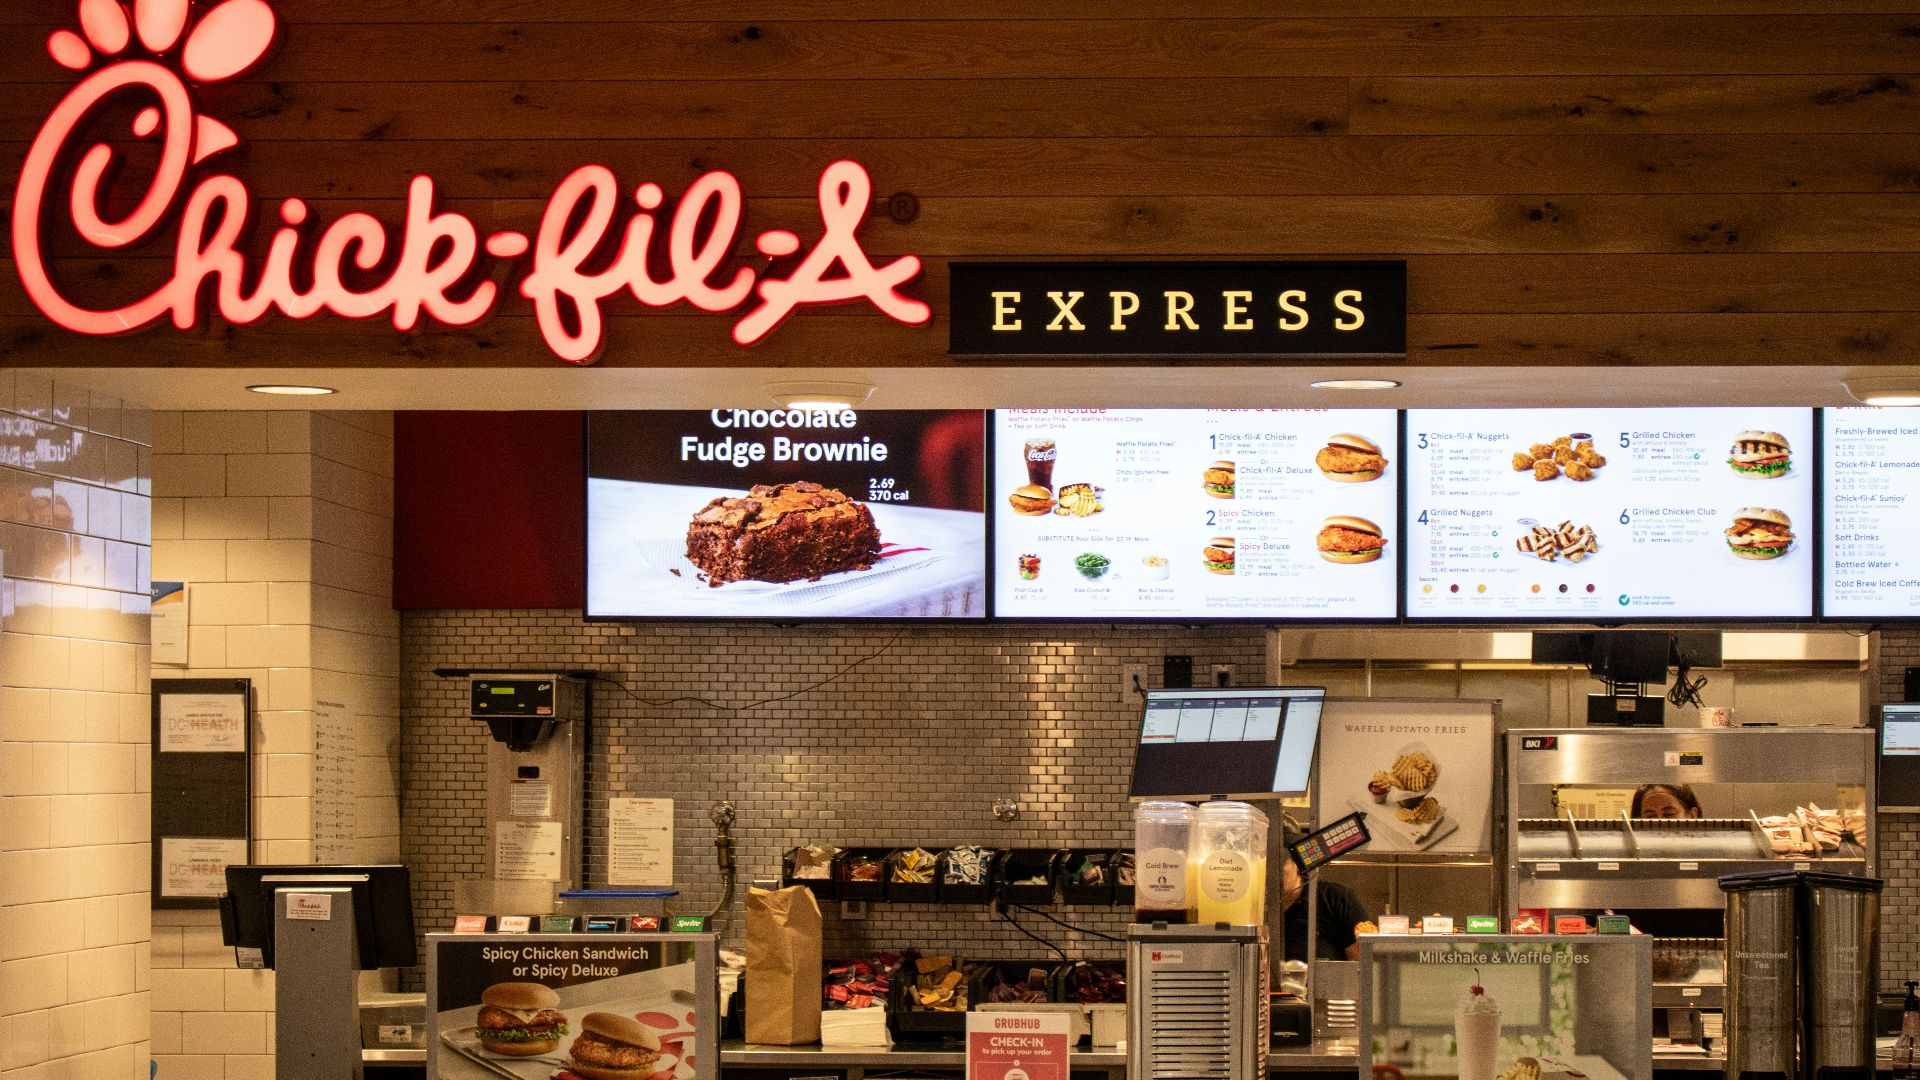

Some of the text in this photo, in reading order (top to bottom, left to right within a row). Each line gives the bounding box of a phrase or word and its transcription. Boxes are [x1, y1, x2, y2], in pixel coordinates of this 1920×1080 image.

[12, 58, 932, 363] Chick-fil-A
[991, 289, 1366, 332] EXPRESS
[711, 408, 857, 429] Chocolate
[1264, 433, 1298, 441] Chicken
[1477, 432, 1510, 442] Nuggets
[1632, 431, 1696, 439] Grilled Chicken
[1835, 427, 1918, 437] Freshly-Brewed Iced
[1209, 434, 1216, 450] 1
[1417, 433, 1428, 450] 3
[1619, 432, 1630, 449] 5
[680, 436, 888, 468] Fudge Brownie
[1286, 466, 1313, 474] Deluxe
[869, 478, 895, 489] 2.69
[869, 490, 909, 501] 370 cal
[1835, 494, 1905, 503] Chick-fil-A Sunjoy
[1218, 509, 1275, 518] Spicy Chicken
[1460, 509, 1493, 518] Nuggets
[1619, 508, 1630, 525] 6
[1632, 508, 1717, 516] Grilled Chicken Club
[1206, 509, 1216, 526] 2
[1417, 509, 1429, 526] 4
[1239, 543, 1261, 552] Spicy
[191, 718, 239, 731] HEALTH
[1345, 725, 1466, 734] WAFFLE POTATO FRIES
[1525, 740, 1541, 748] BKI
[677, 920, 701, 928] Sprite
[1471, 920, 1495, 928] Sprite
[482, 947, 649, 963] Spicy Chicken Sandwich
[1419, 951, 1590, 964] Milkshake & Waffle Fries
[1735, 950, 1789, 959] Unsweetened
[1839, 955, 1855, 963] Tea
[1754, 961, 1770, 969] Tea
[512, 964, 619, 979] or Spicy Deluxe
[994, 1018, 1041, 1029] GRUBHUB
[990, 1037, 1044, 1048] CHECK-IN
[990, 1048, 1005, 1056] pick
